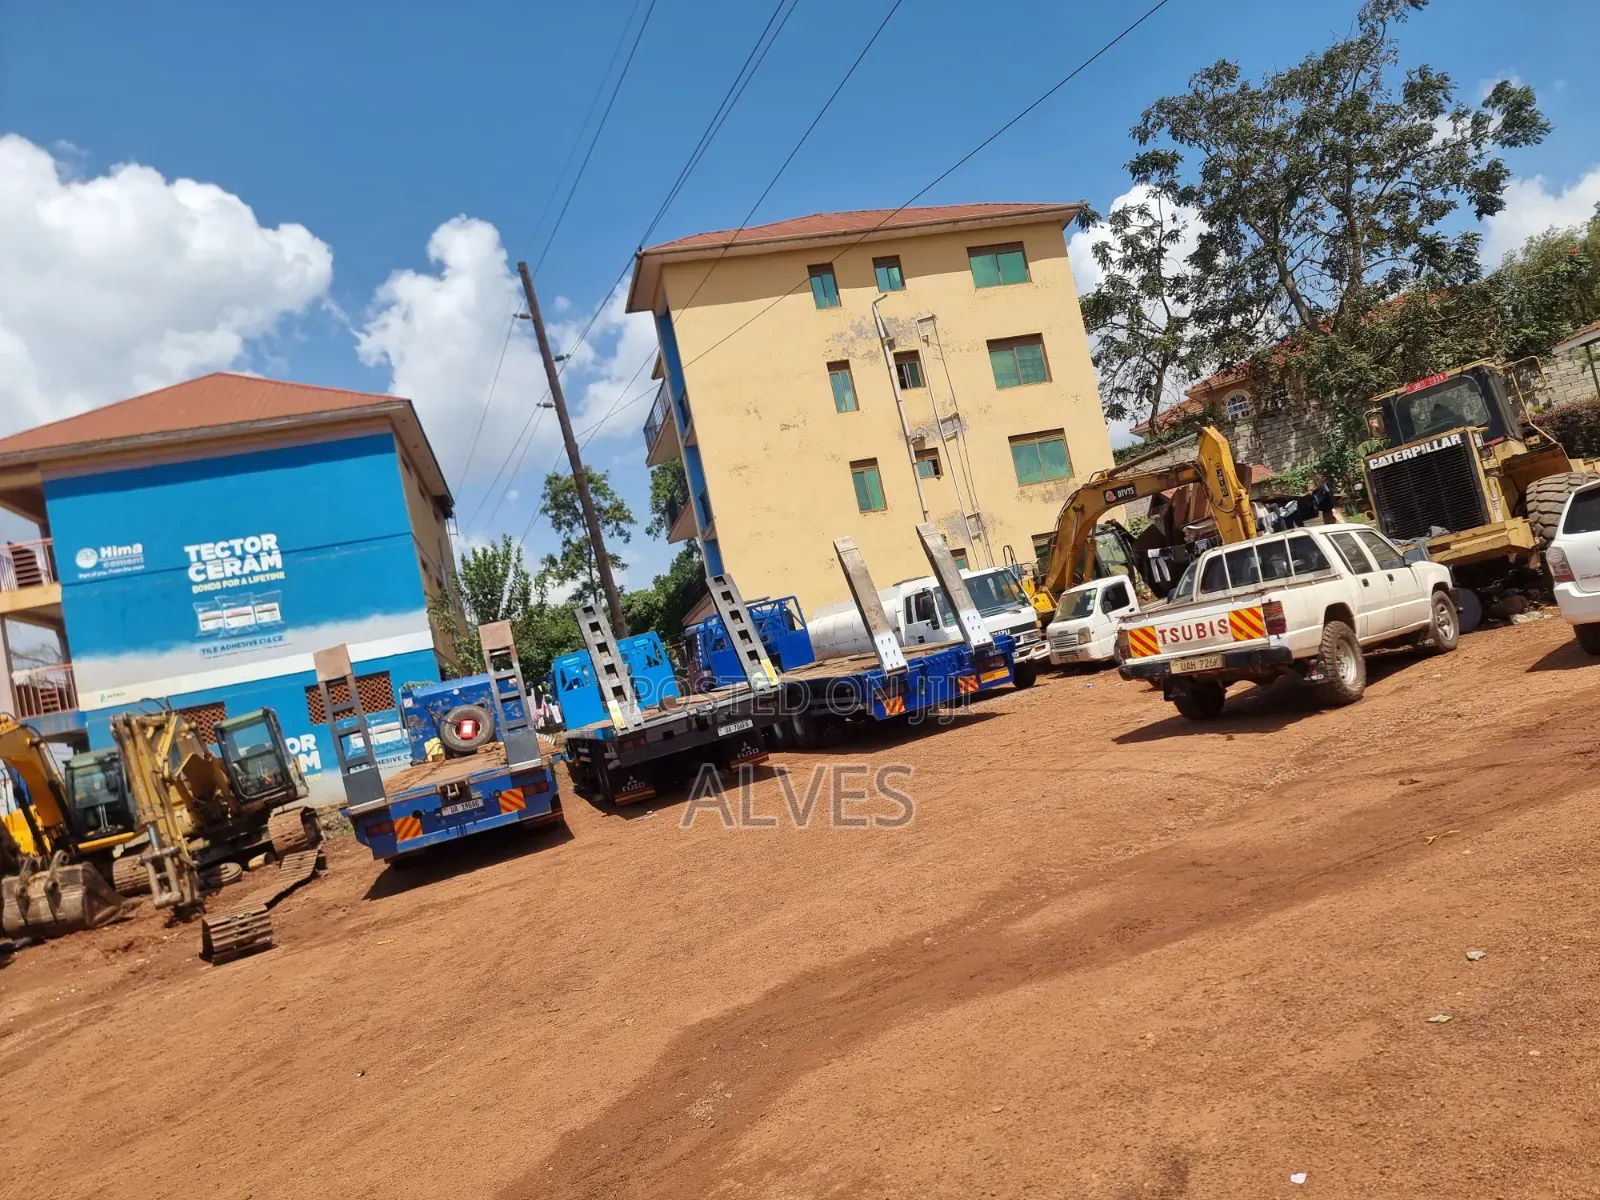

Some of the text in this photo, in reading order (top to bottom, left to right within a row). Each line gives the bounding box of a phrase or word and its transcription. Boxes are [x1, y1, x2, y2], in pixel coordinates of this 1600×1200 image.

[1368, 433, 1462, 470] CATERPILLAR
[101, 543, 143, 558] Hima
[184, 533, 279, 562] TECTOR
[188, 550, 283, 582] CERAM
[192, 571, 286, 594] BONDS FOR A LIFETIME
[1158, 618, 1229, 645] TSUBIS
[201, 647, 219, 656] TILE
[220, 639, 258, 651] ADHESIVE
[1180, 657, 1220, 671] UAH 726K
[737, 747, 760, 759] FUSO
[622, 781, 646, 792] FUSO
